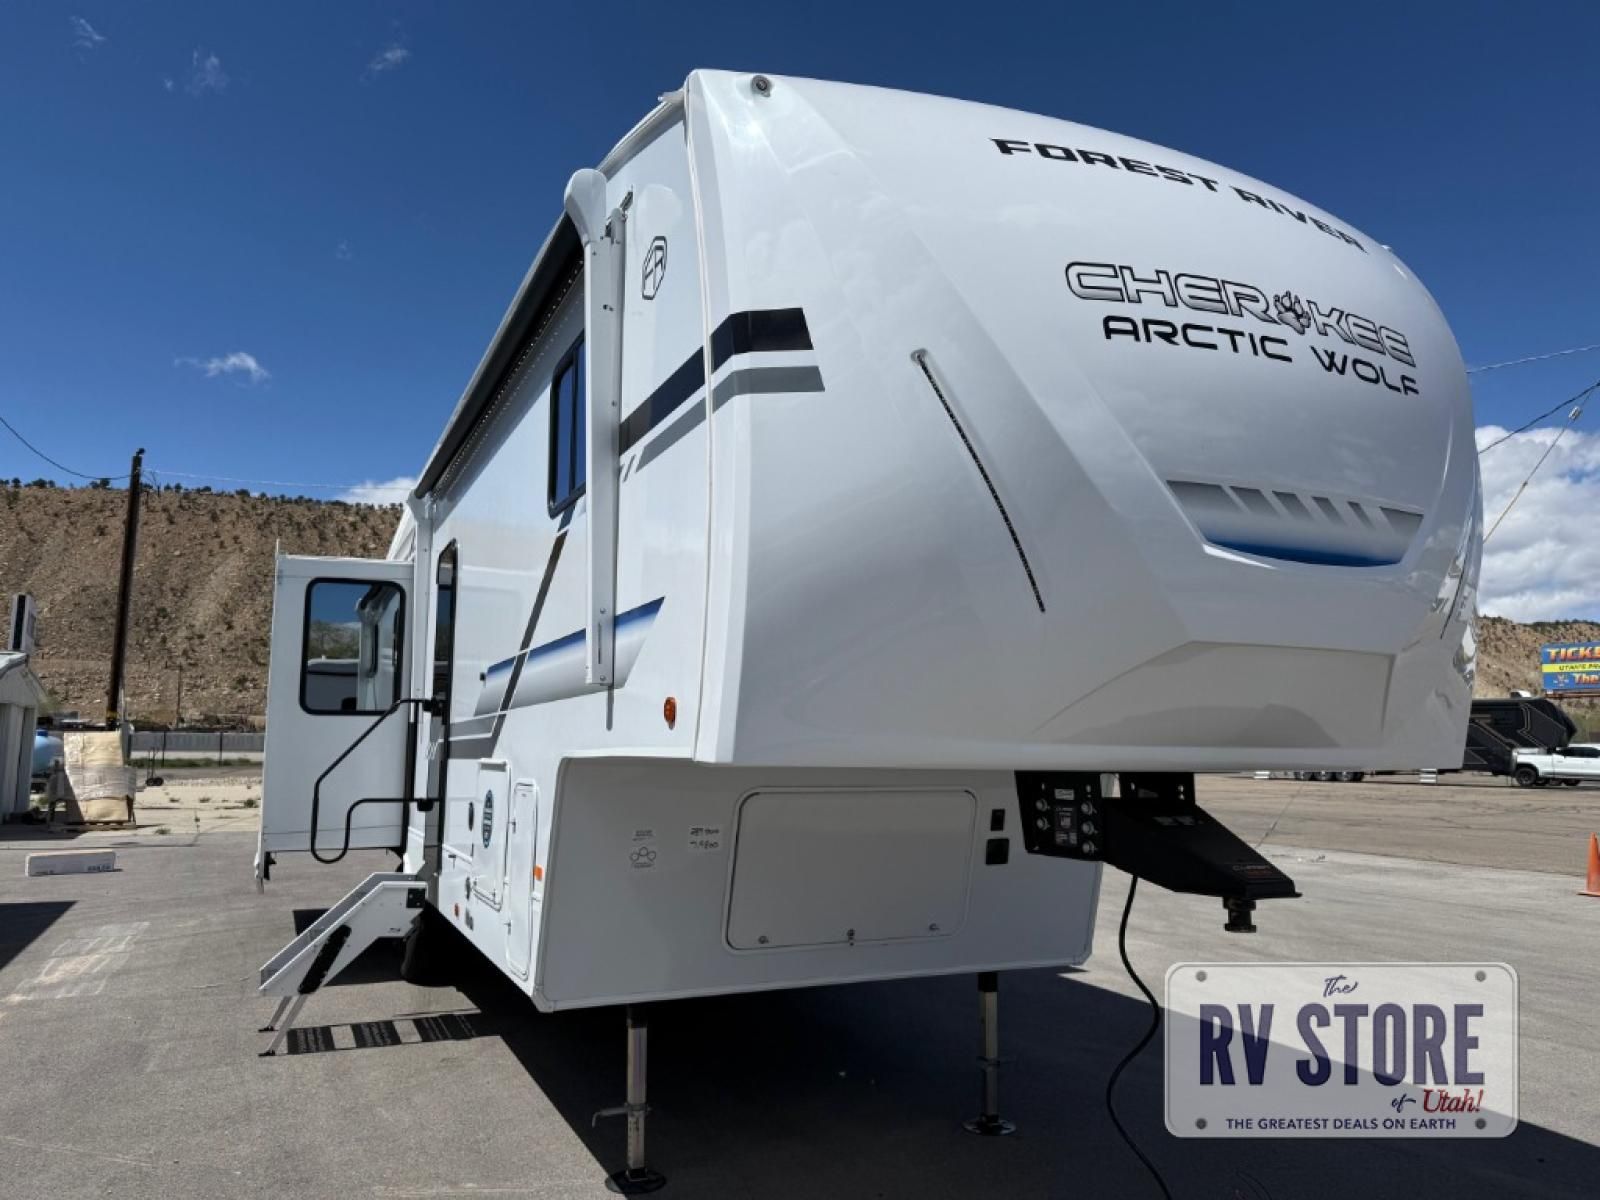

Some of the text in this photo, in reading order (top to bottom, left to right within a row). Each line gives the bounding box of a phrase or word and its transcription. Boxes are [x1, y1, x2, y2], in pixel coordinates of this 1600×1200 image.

[991, 138, 1367, 253] FOREST RIVER
[1065, 261, 1417, 368] CHERKEE
[1102, 315, 1419, 395] ARCTIC WOLF
